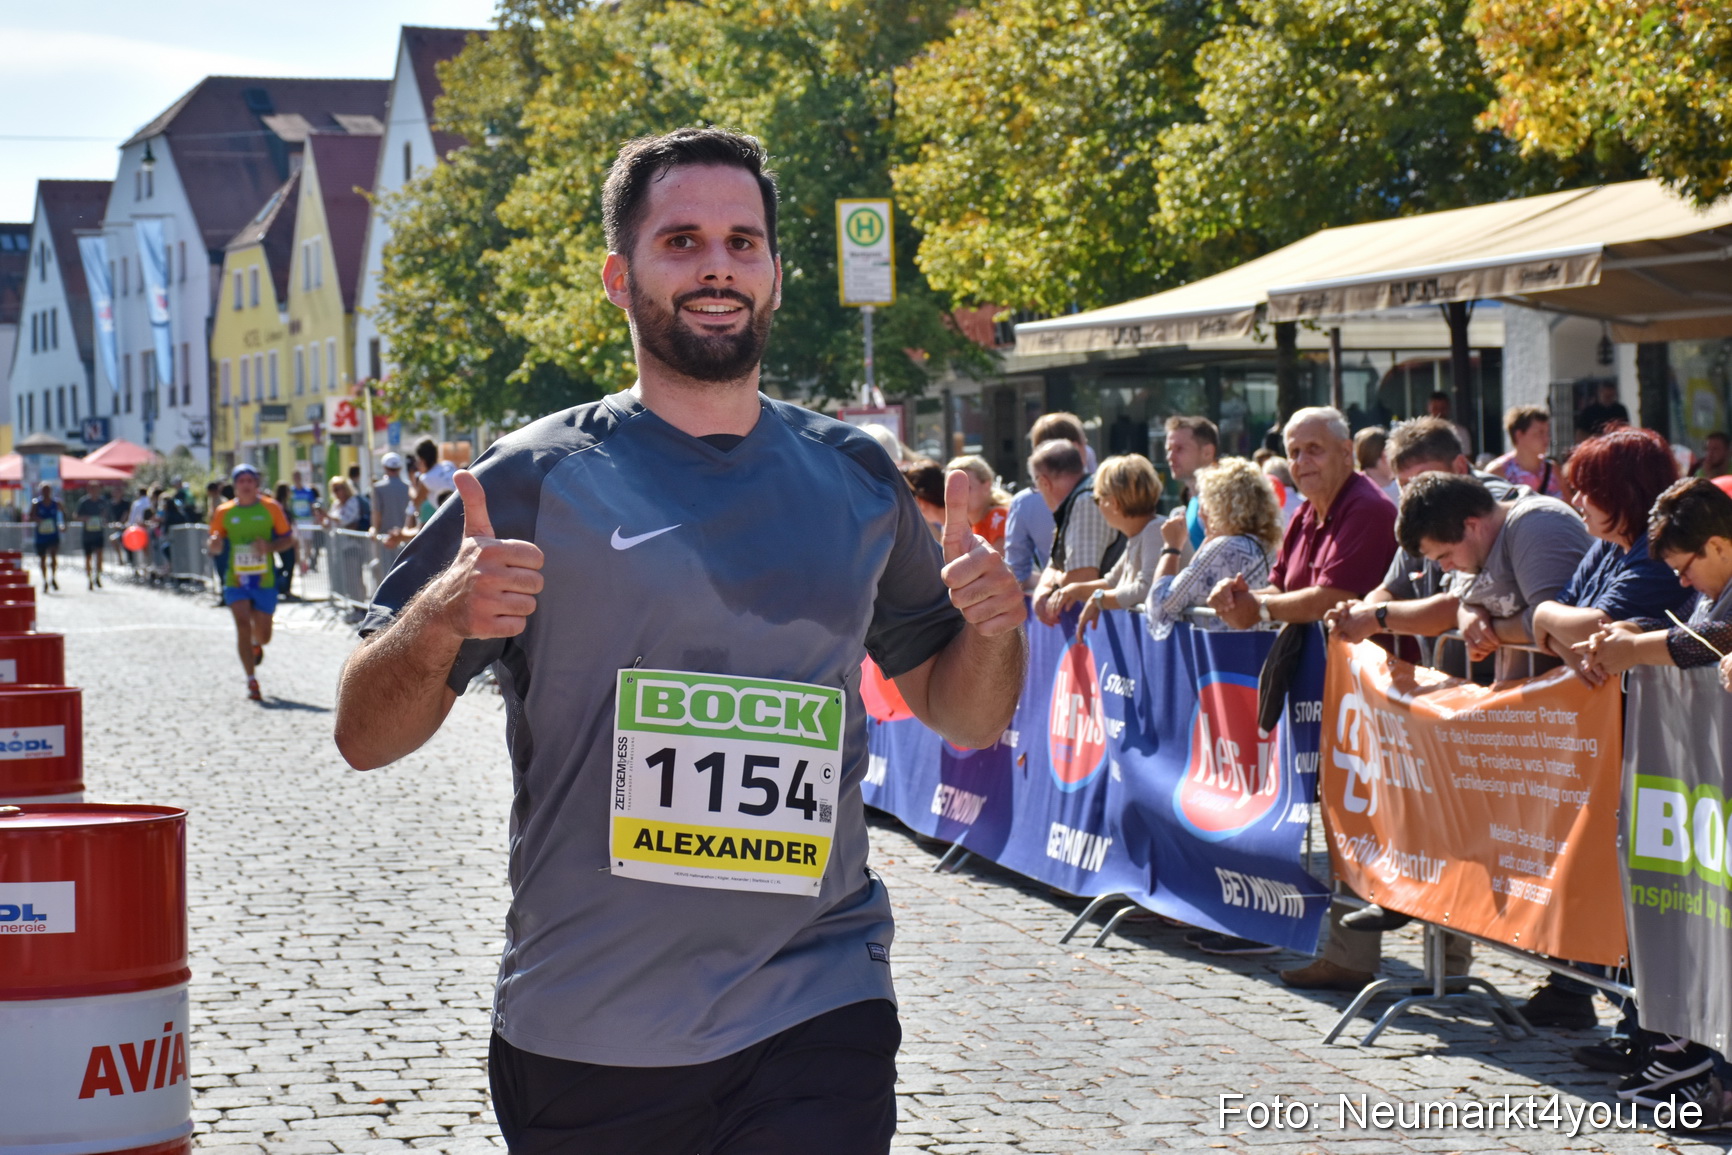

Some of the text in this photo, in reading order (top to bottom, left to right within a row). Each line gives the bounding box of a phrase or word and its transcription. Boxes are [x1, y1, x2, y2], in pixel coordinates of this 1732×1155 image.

[1103, 673, 1135, 698] STORE
[638, 682, 827, 738] BOCK
[1295, 700, 1323, 723] STOR
[1488, 705, 1537, 723] moderner
[1538, 706, 1579, 725] Partner
[1374, 707, 1414, 751] CODE
[1449, 729, 1464, 744] die
[1463, 730, 1519, 751] Konzeption
[1519, 731, 1538, 748] und
[1538, 731, 1598, 758] Umsetzung
[822, 766, 832, 780] C
[1456, 750, 1479, 769] Ihrer
[1479, 752, 1523, 774] Projekte
[1544, 757, 1581, 779] Internet,
[645, 747, 818, 821] 1154
[1509, 778, 1526, 796] und
[633, 828, 818, 867] ALEXANDER
[1489, 823, 1517, 844] Melden
[1517, 828, 1529, 847] Sie
[1628, 876, 1703, 916] inspired
[0, 903, 47, 922] DL
[0, 919, 47, 934] nergie
